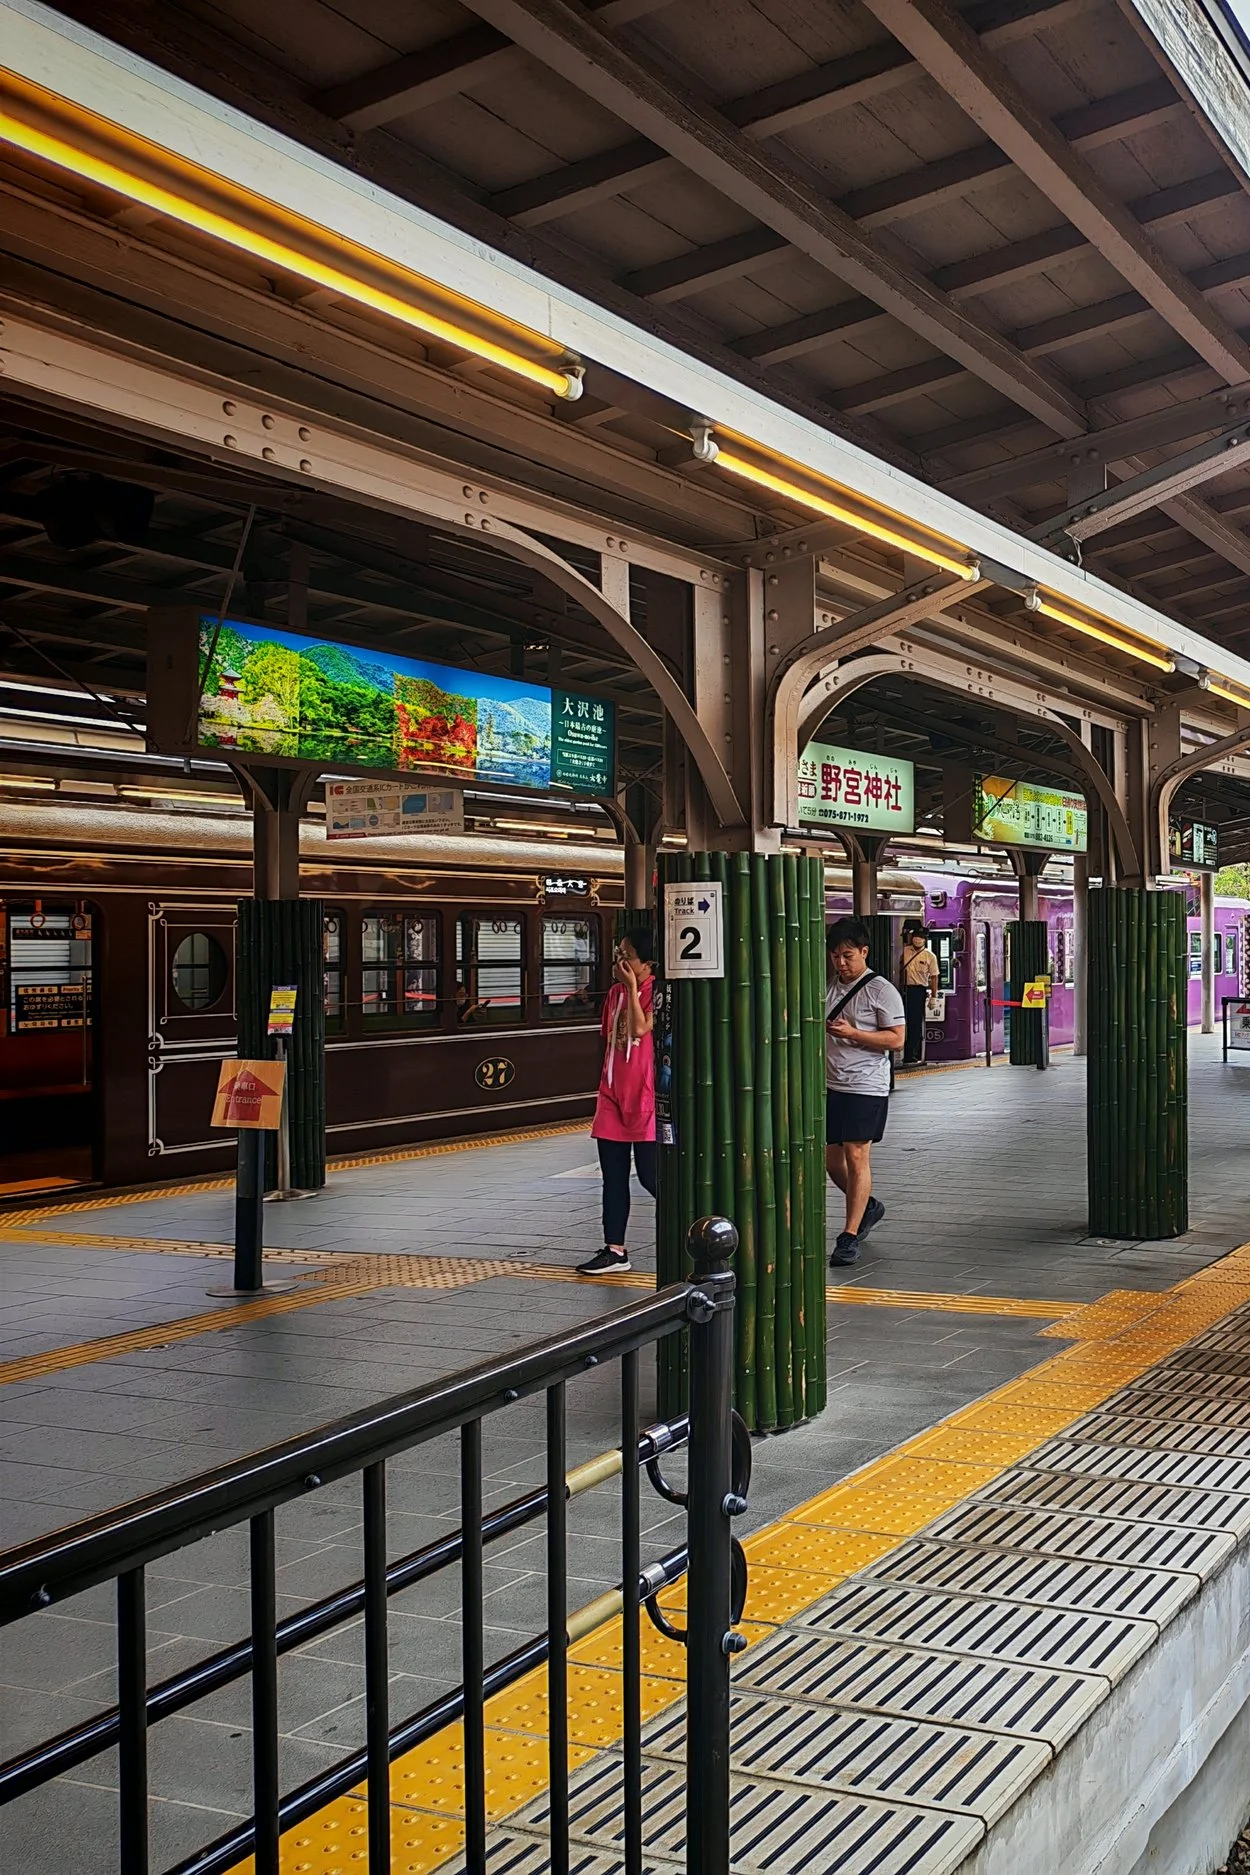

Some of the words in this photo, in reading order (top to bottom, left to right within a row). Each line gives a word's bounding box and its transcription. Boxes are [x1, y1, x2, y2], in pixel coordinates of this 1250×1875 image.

[562, 697, 605, 722] 大沢池
[798, 759, 817, 777] さま
[820, 763, 902, 811] 野宮神社
[674, 897, 695, 905] のりば
[674, 907, 695, 915] Track
[680, 926, 702, 960] 2
[926, 1030, 941, 1040] 05
[482, 1062, 508, 1086] 27
[225, 1095, 262, 1105] Entrance
